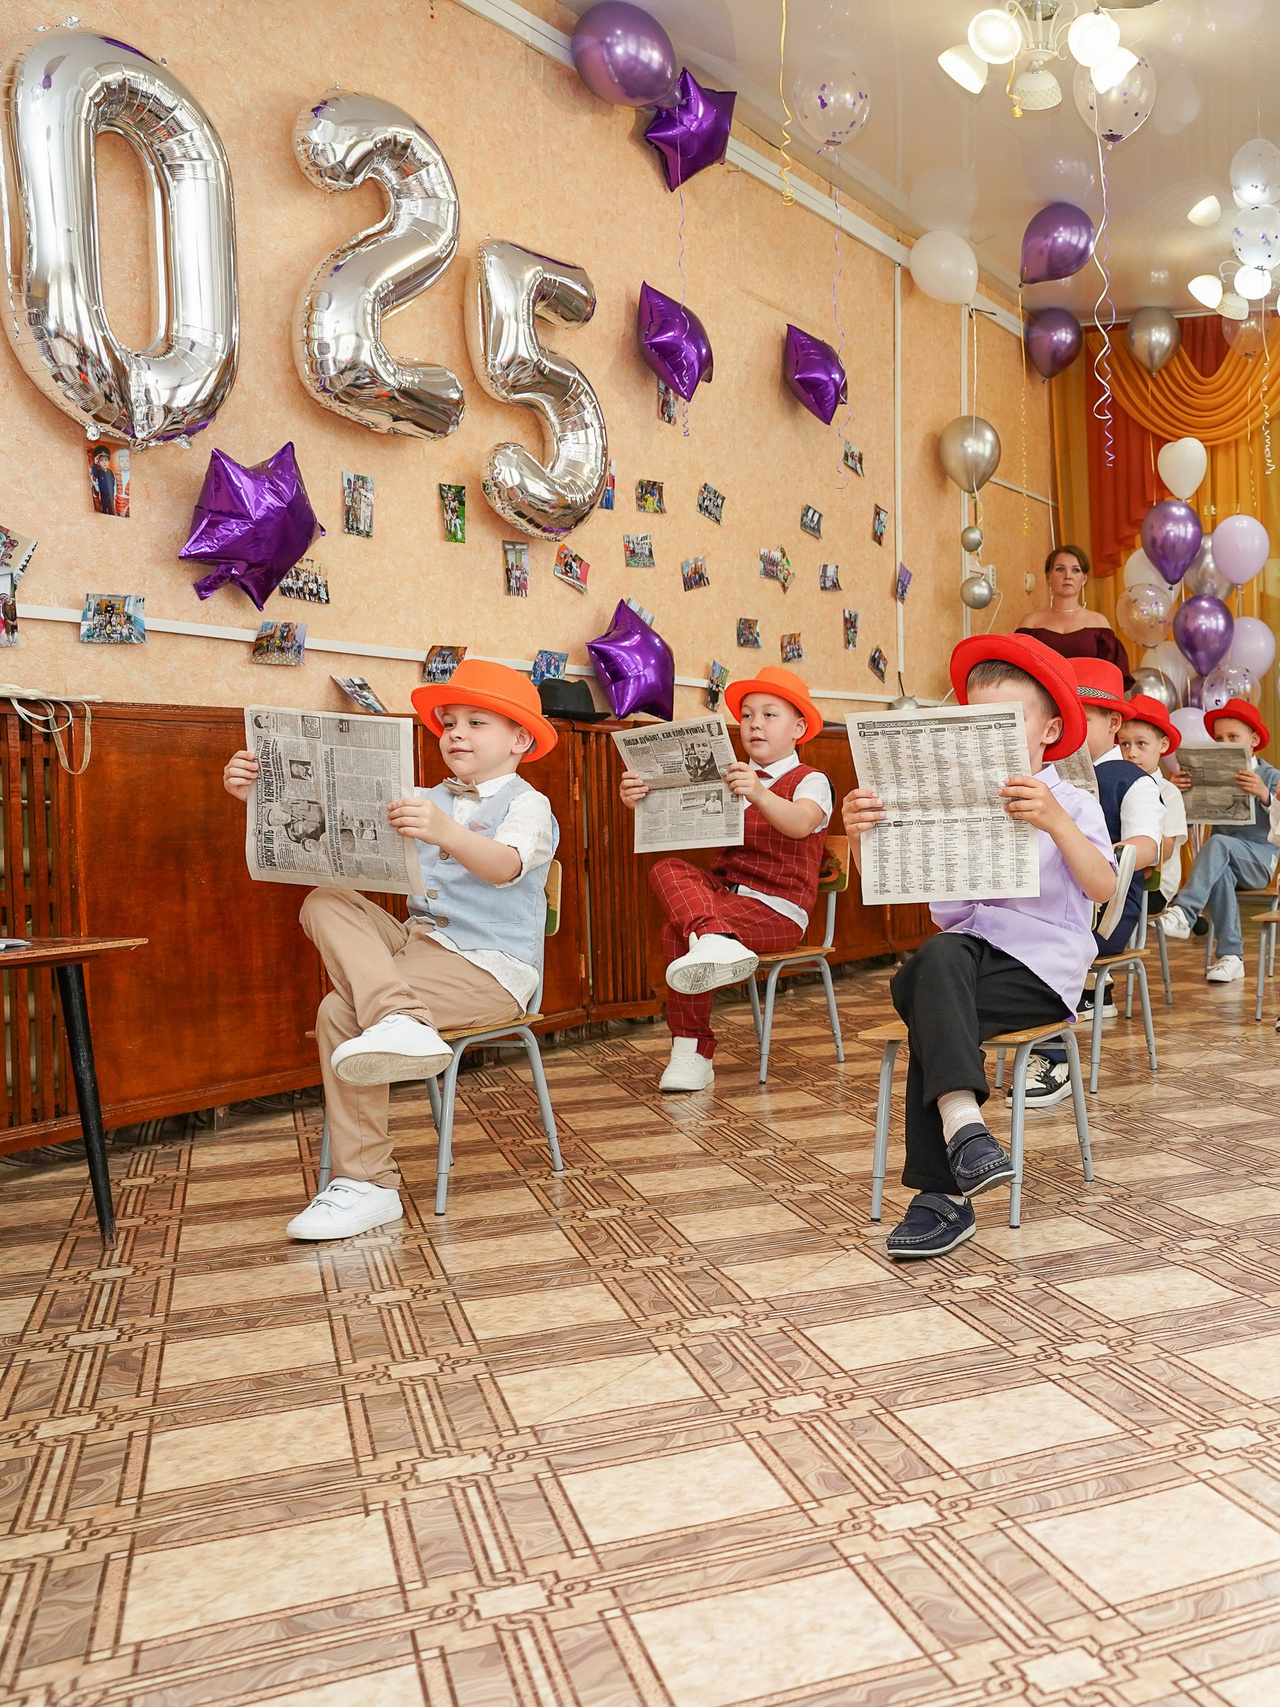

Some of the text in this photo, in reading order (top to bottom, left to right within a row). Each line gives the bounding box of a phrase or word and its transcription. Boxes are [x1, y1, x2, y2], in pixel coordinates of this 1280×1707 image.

[622, 738, 640, 747] Люди
[661, 731, 673, 740] как
[673, 727, 686, 738] хлеб
[260, 739, 272, 760] СЦЕНУ!
[262, 760, 271, 768] НА
[262, 768, 275, 798] ВЕРНЕТСЯ
[263, 829, 277, 867] БРОСИТ ПИТЬ
